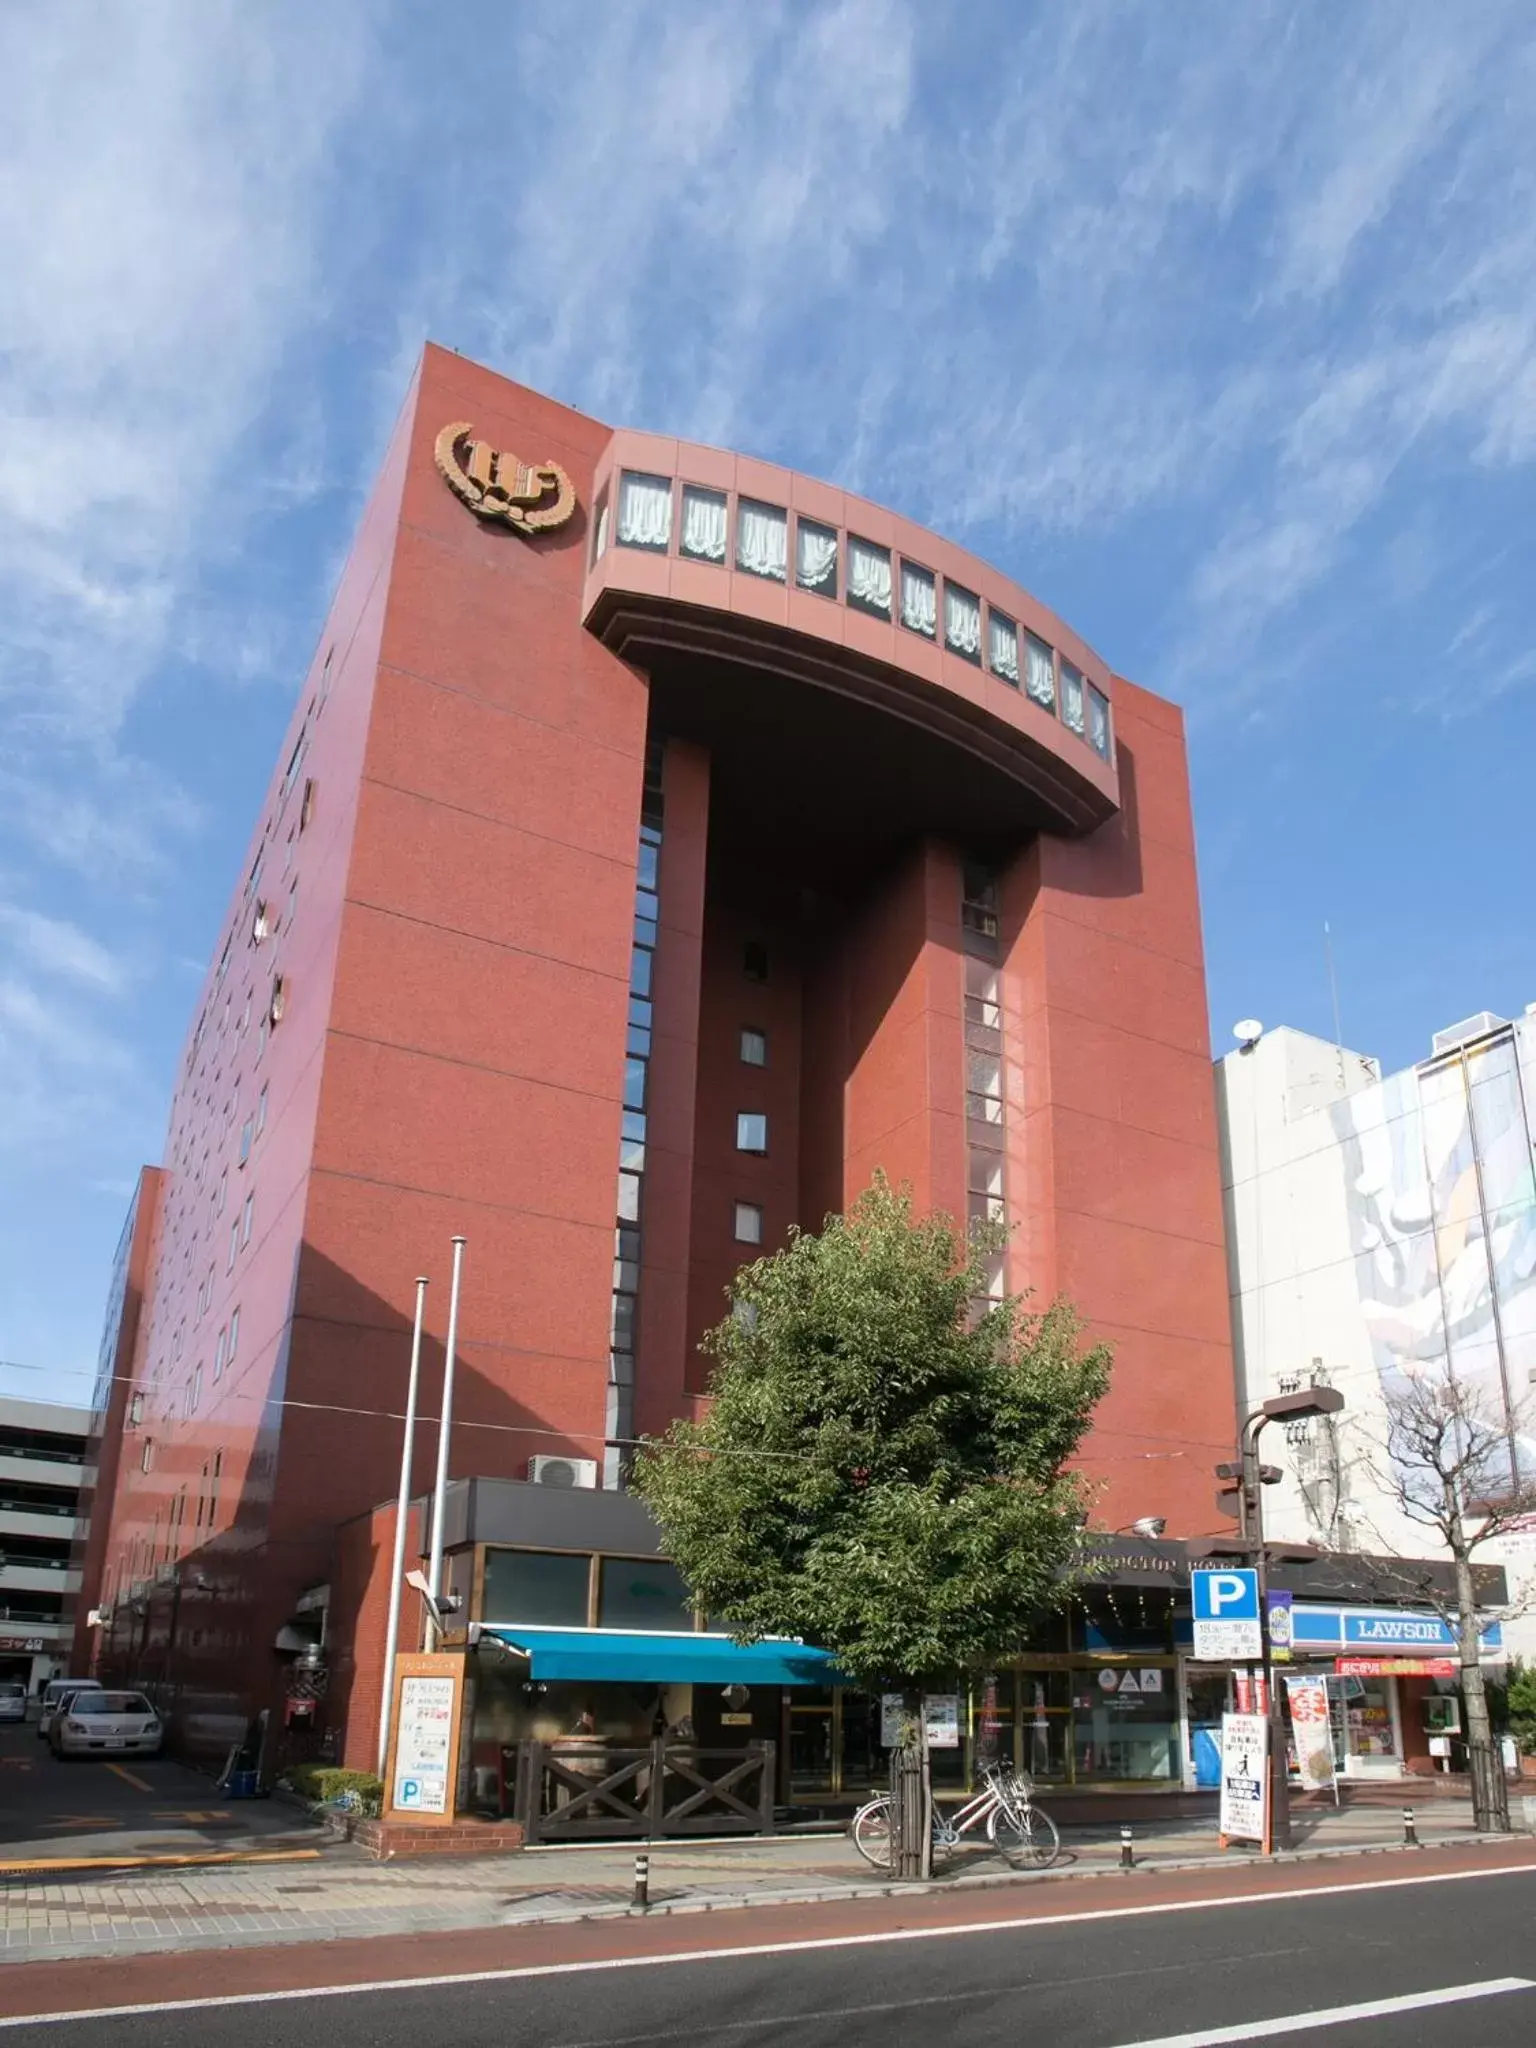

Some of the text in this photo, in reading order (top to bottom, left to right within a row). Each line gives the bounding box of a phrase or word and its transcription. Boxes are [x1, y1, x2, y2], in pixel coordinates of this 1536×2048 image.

[1208, 1574, 1246, 1616] P
[1357, 1620, 1442, 1640] LAWSON
[403, 1780, 418, 1803] P
